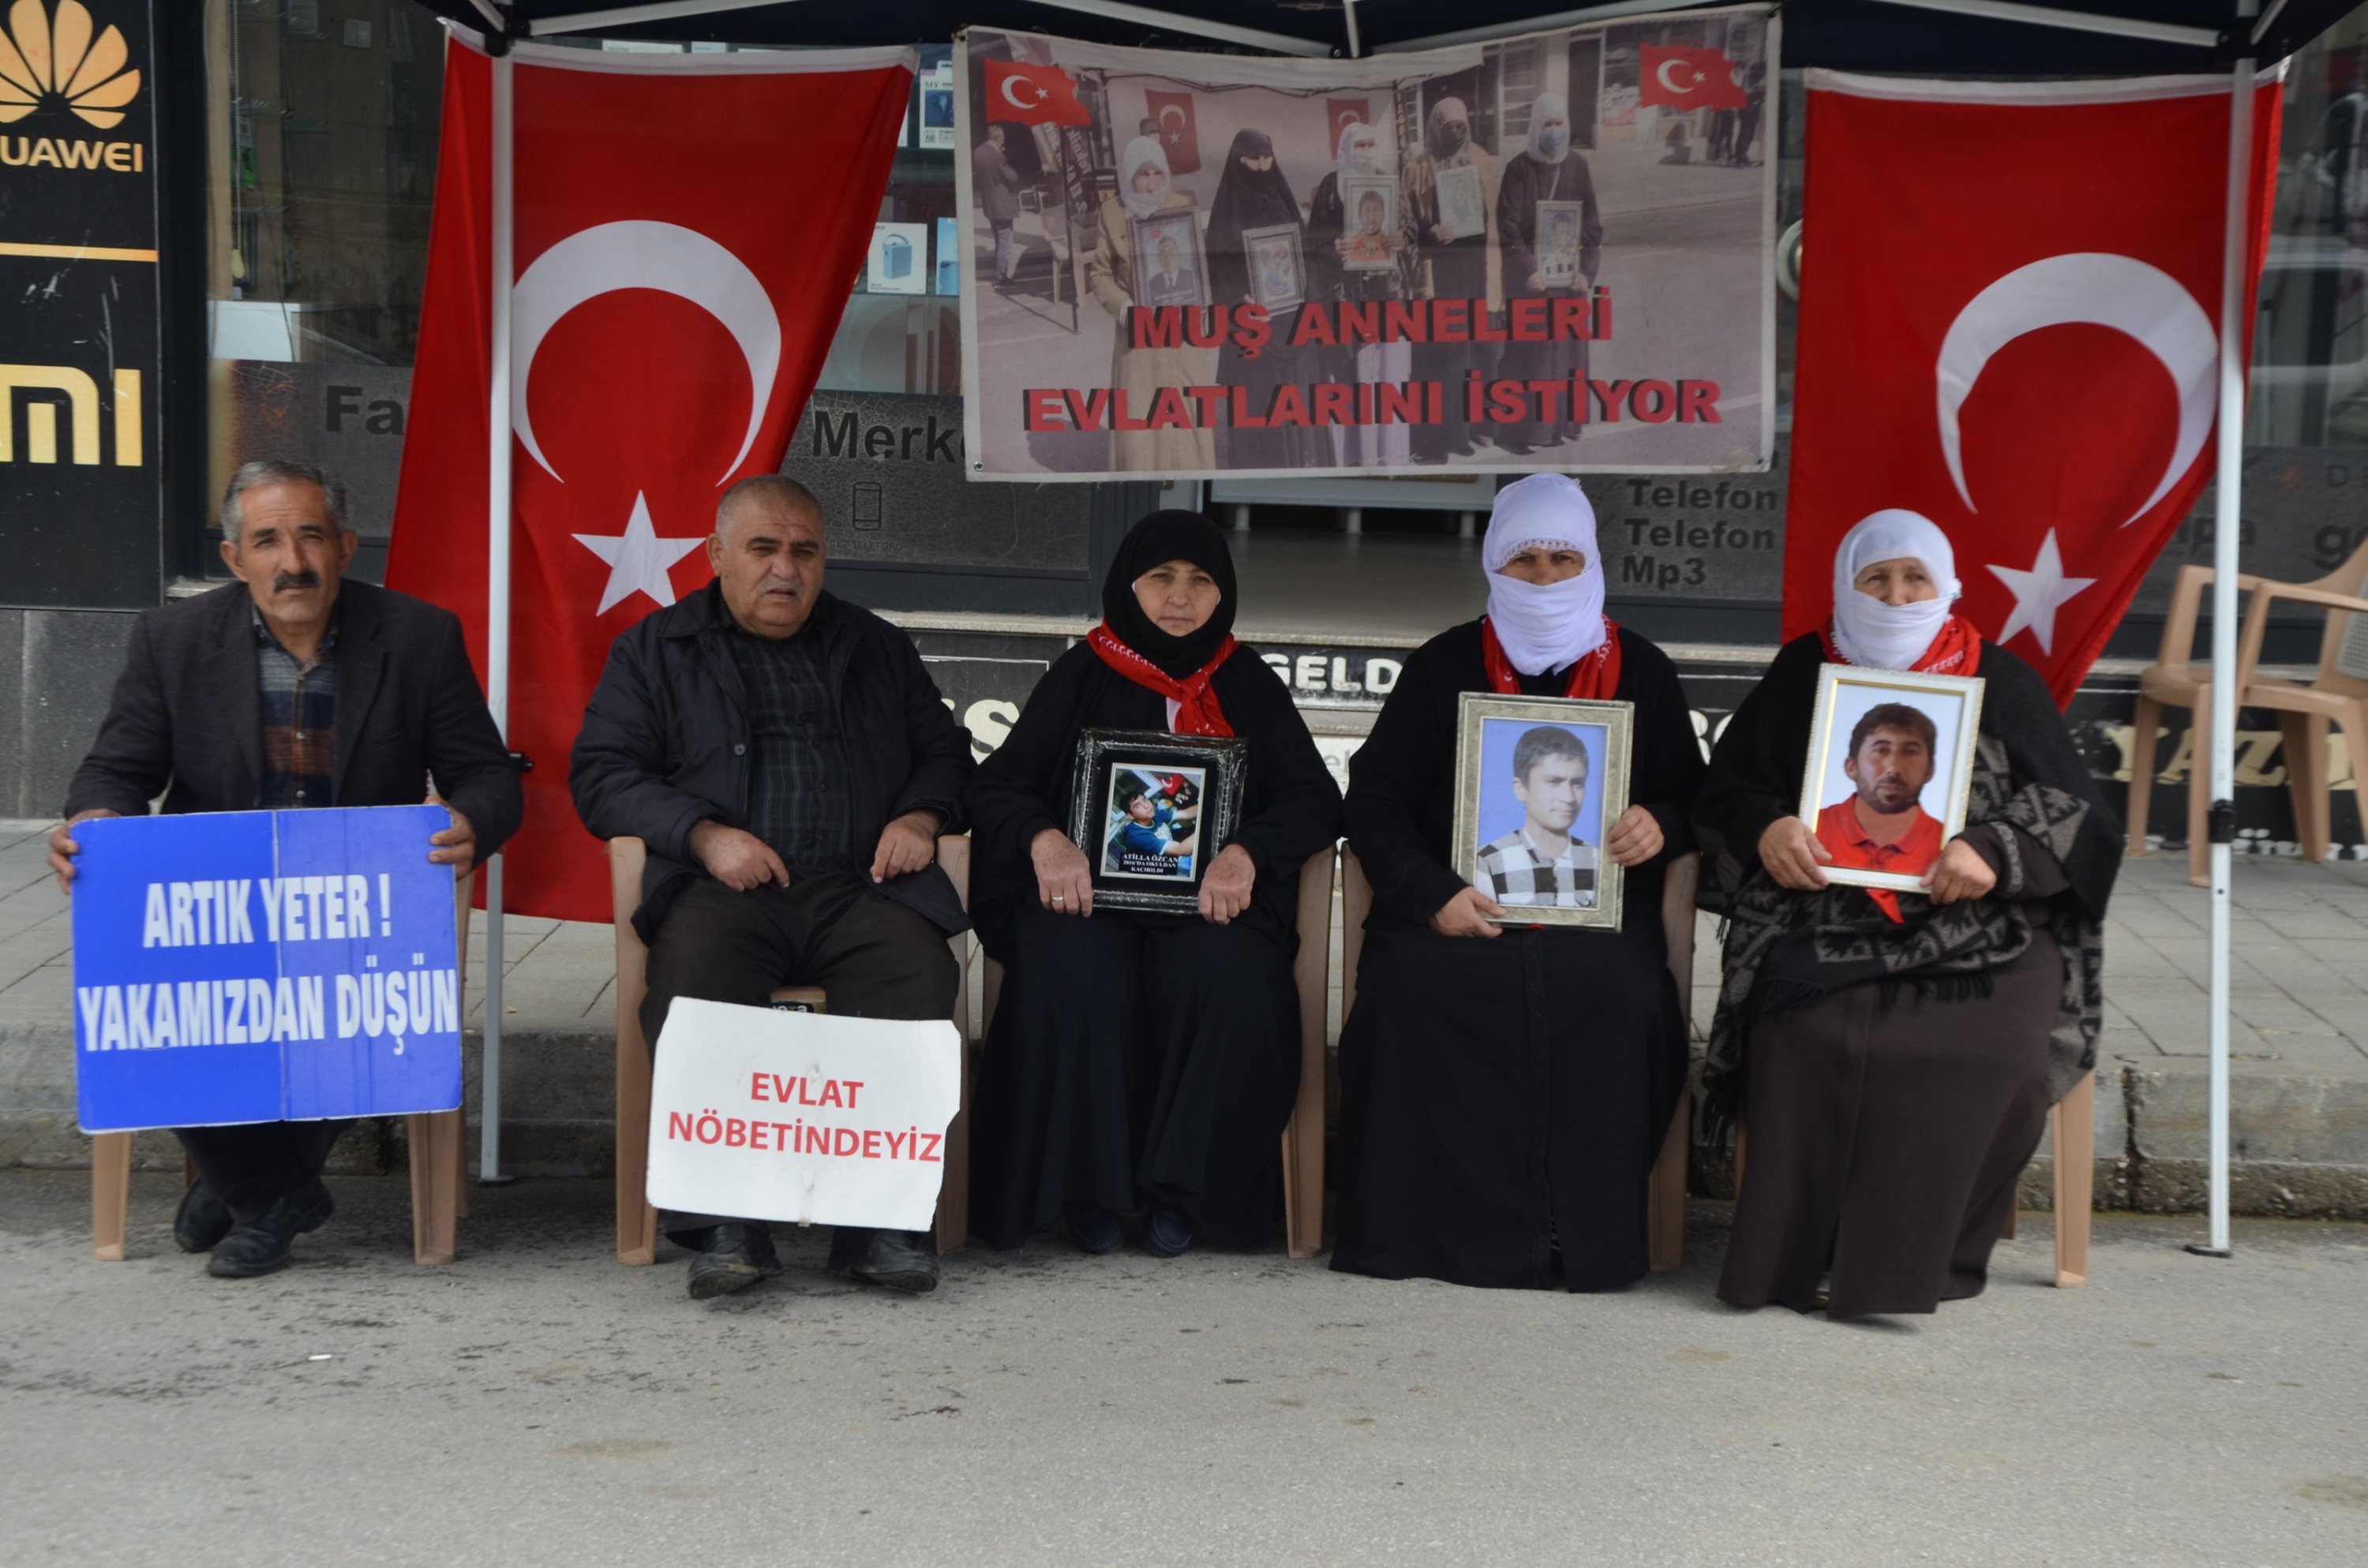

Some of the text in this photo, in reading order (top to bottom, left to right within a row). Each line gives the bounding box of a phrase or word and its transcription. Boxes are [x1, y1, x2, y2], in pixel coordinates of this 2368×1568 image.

[0, 135, 143, 172] UAWEI
[1128, 286, 1613, 361] MUŞ ANNELERİ
[1023, 369, 1722, 432] EVLATLARINI İSTİYOR
[813, 410, 965, 462] Merk
[1626, 478, 1778, 511] Telefon
[1624, 518, 1775, 550] Telefon
[1622, 555, 1706, 590] Mp3
[1122, 852, 1178, 863] ATİLLA ÖZCAN
[144, 878, 254, 948] ARTIK
[77, 952, 459, 1056] YAKAMIZDAN DÜŞÜN
[751, 1072, 864, 1109] EVLAT
[668, 1108, 942, 1162] NÖBETİNDEYİZ
